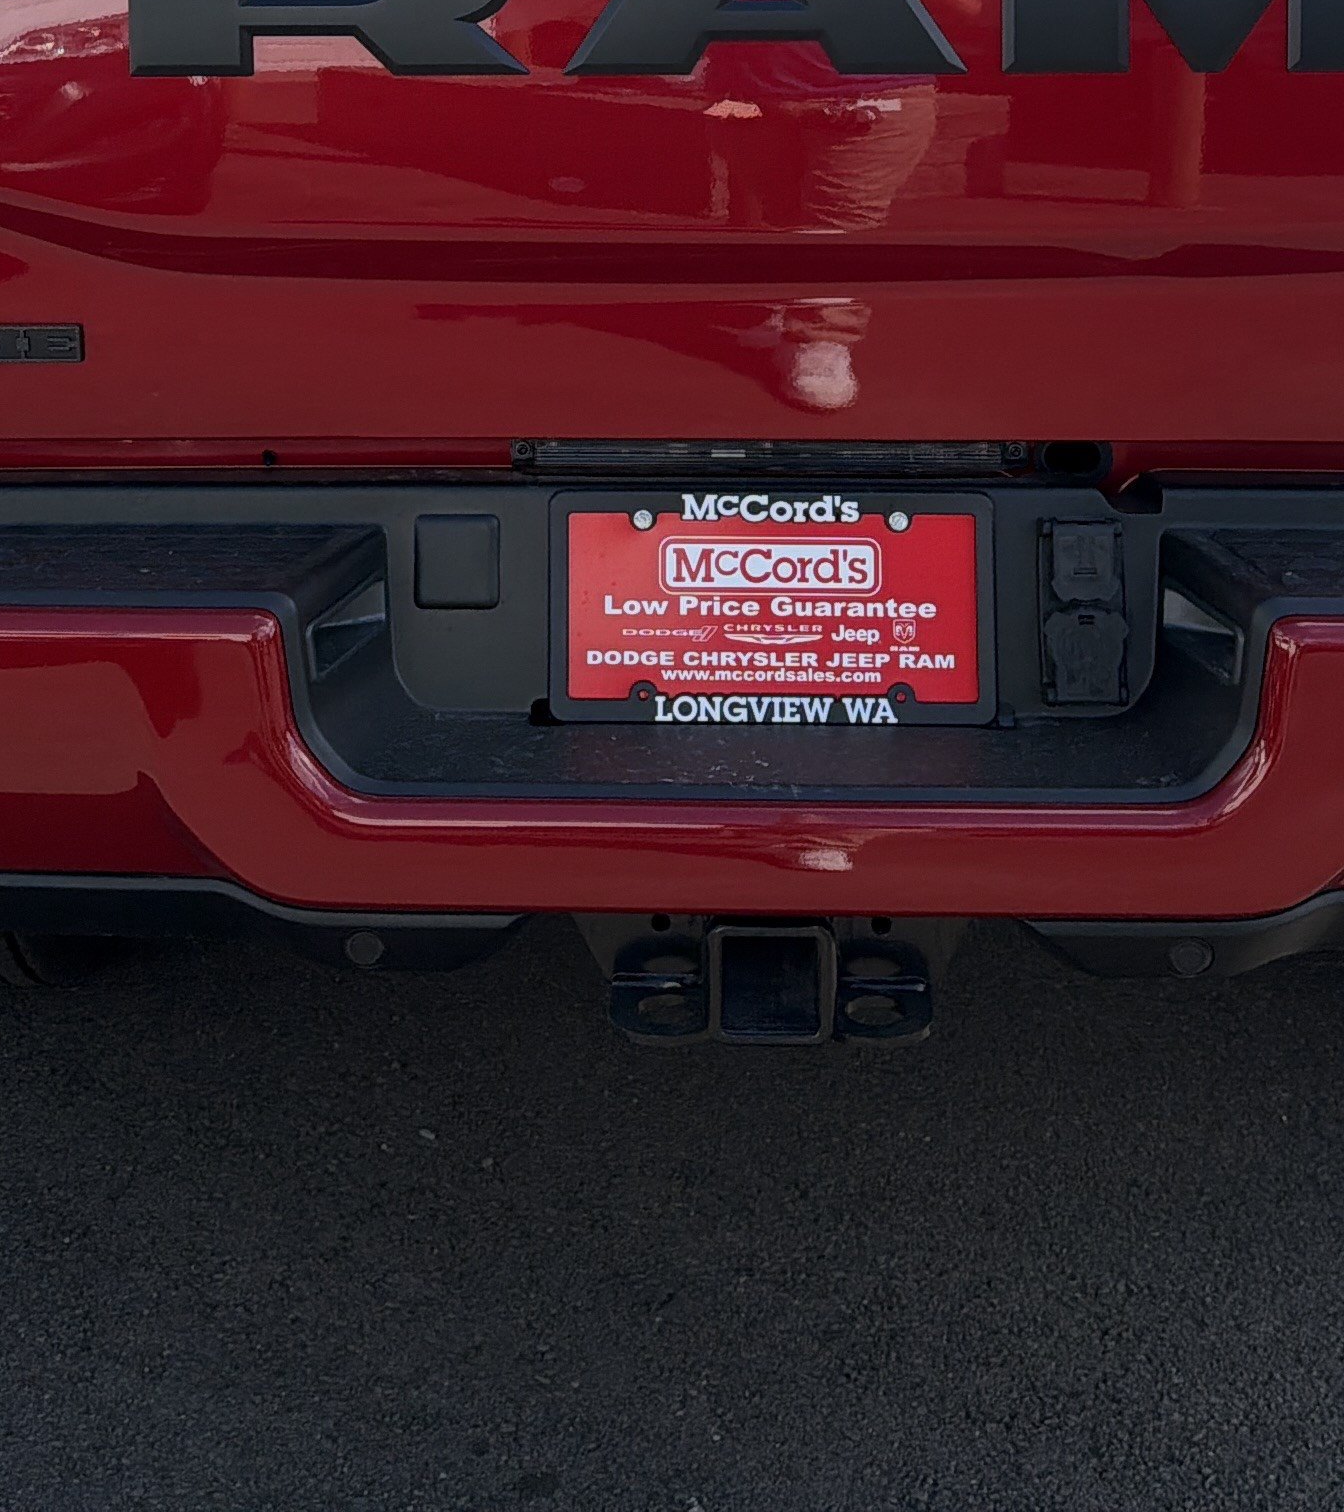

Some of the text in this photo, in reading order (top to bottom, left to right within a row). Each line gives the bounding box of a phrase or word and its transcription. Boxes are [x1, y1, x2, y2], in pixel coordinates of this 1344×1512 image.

[680, 493, 859, 524] McCord's
[671, 547, 869, 585] McCord's
[603, 595, 938, 619] Low Price Guarantee
[722, 623, 824, 633] CHRYSLER
[830, 624, 880, 646] Jeep
[586, 650, 956, 669] DODGE CHRYSLER JEEP RAM
[660, 667, 882, 683] www.mccordsales.com
[654, 694, 899, 725] LONGVIEW WA
